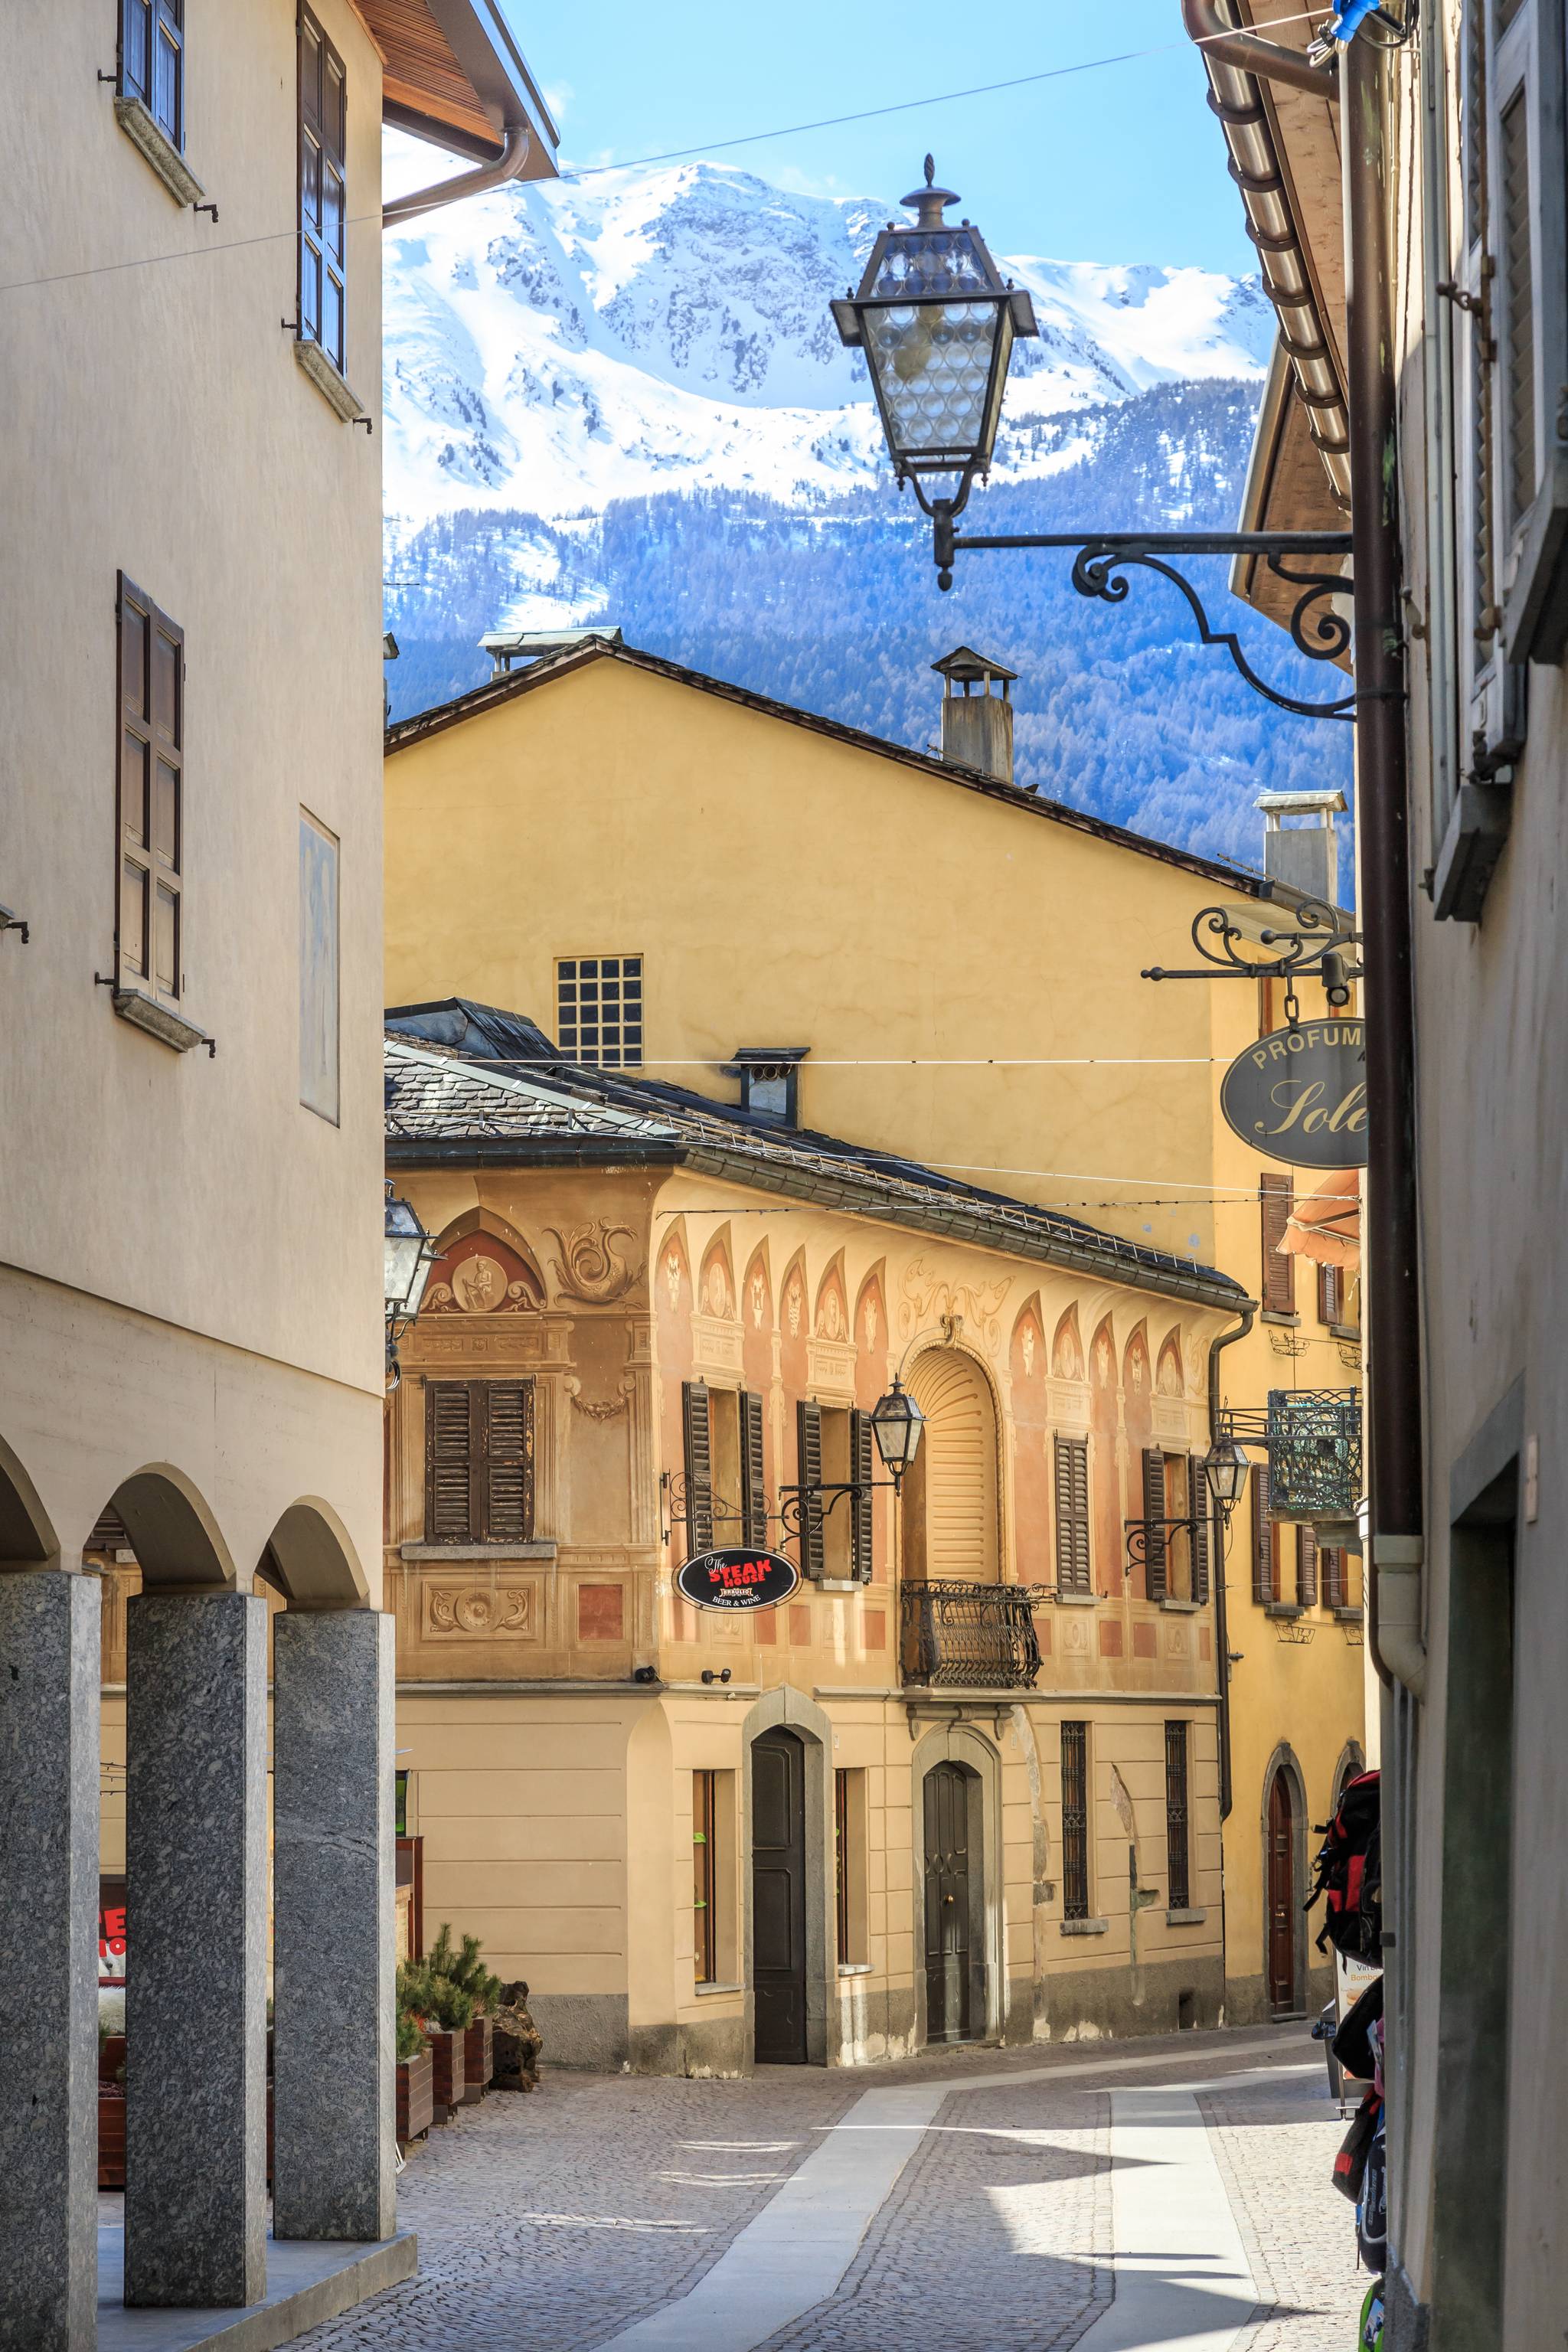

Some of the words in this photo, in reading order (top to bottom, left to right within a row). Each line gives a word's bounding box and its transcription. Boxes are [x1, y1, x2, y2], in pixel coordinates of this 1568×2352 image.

[1252, 1027, 1365, 1070] PROFUM
[704, 1556, 727, 1574] The
[709, 1559, 772, 1583] STEAK
[724, 1573, 766, 1588] HOUSE
[712, 1596, 732, 1606] BEER
[740, 1595, 761, 1606] WINE
